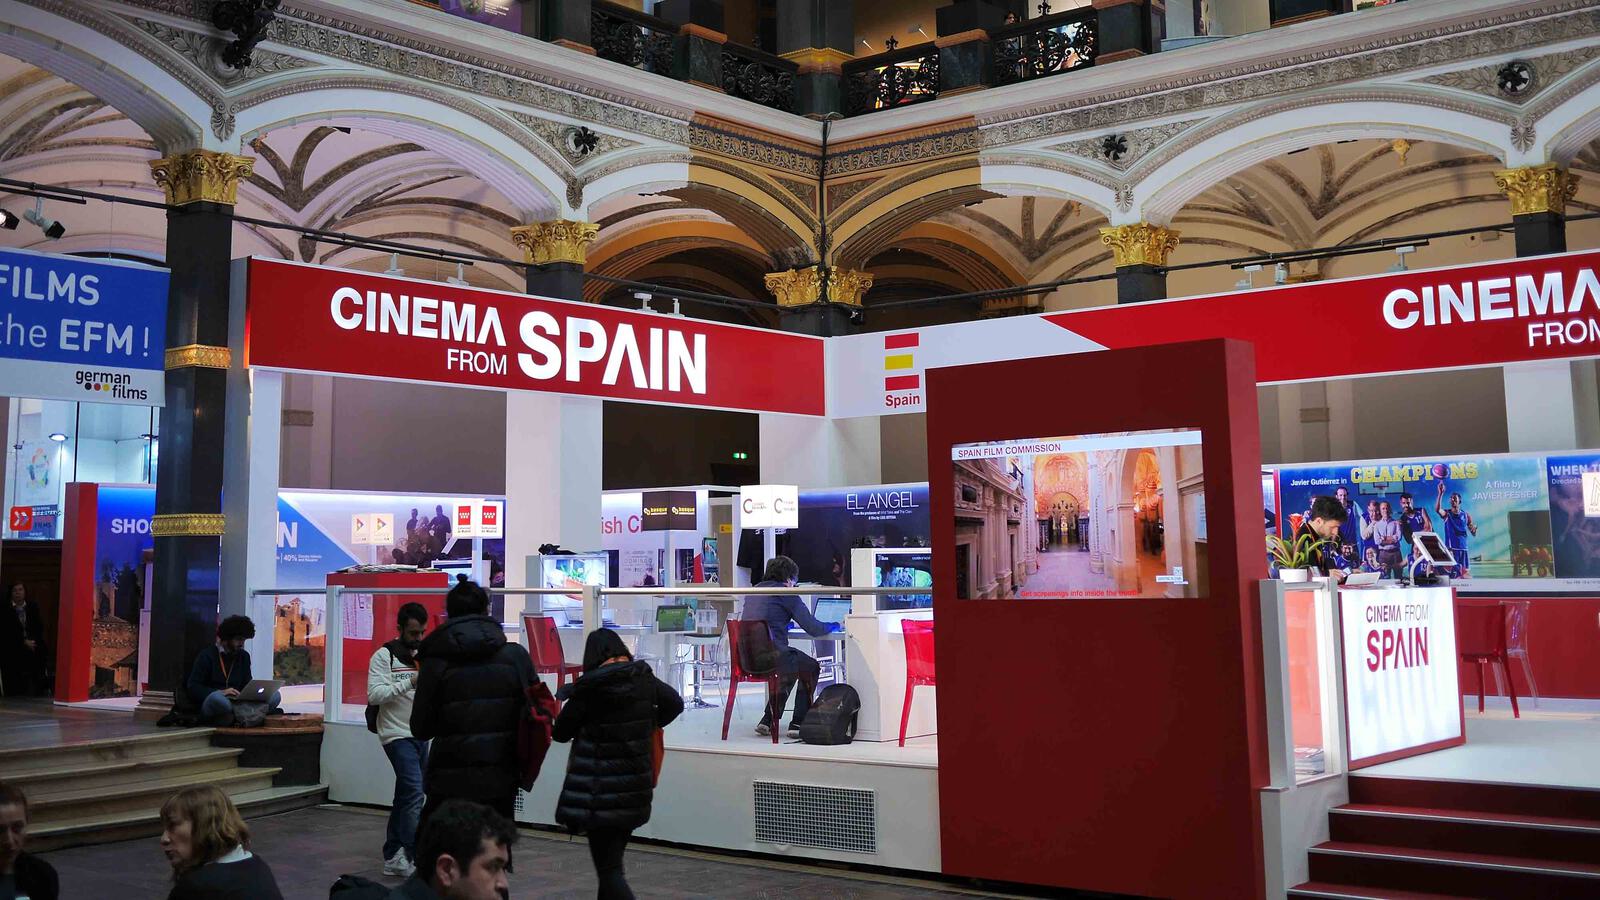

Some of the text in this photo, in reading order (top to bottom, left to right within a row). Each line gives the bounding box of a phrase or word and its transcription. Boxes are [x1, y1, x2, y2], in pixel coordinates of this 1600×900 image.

[1382, 269, 1600, 329] CINEMA
[330, 286, 507, 346] CINEMA
[0, 312, 47, 348] he
[60, 318, 133, 355] EFM
[518, 310, 707, 394] SPAIN
[447, 348, 507, 376] FROM
[75, 369, 131, 385] german
[112, 385, 148, 400] films
[885, 393, 920, 408] Spain
[958, 443, 1061, 458] SPAIN FILM COMMISSION
[1550, 464, 1588, 476] WHEN
[1310, 478, 1340, 486] Gutiérrez
[1485, 479, 1522, 489] A film by
[846, 491, 919, 510] EL ANGEL
[111, 518, 154, 534] SHO
[1366, 604, 1429, 623] CINEMA FROM
[1366, 627, 1429, 672] SPAIN
